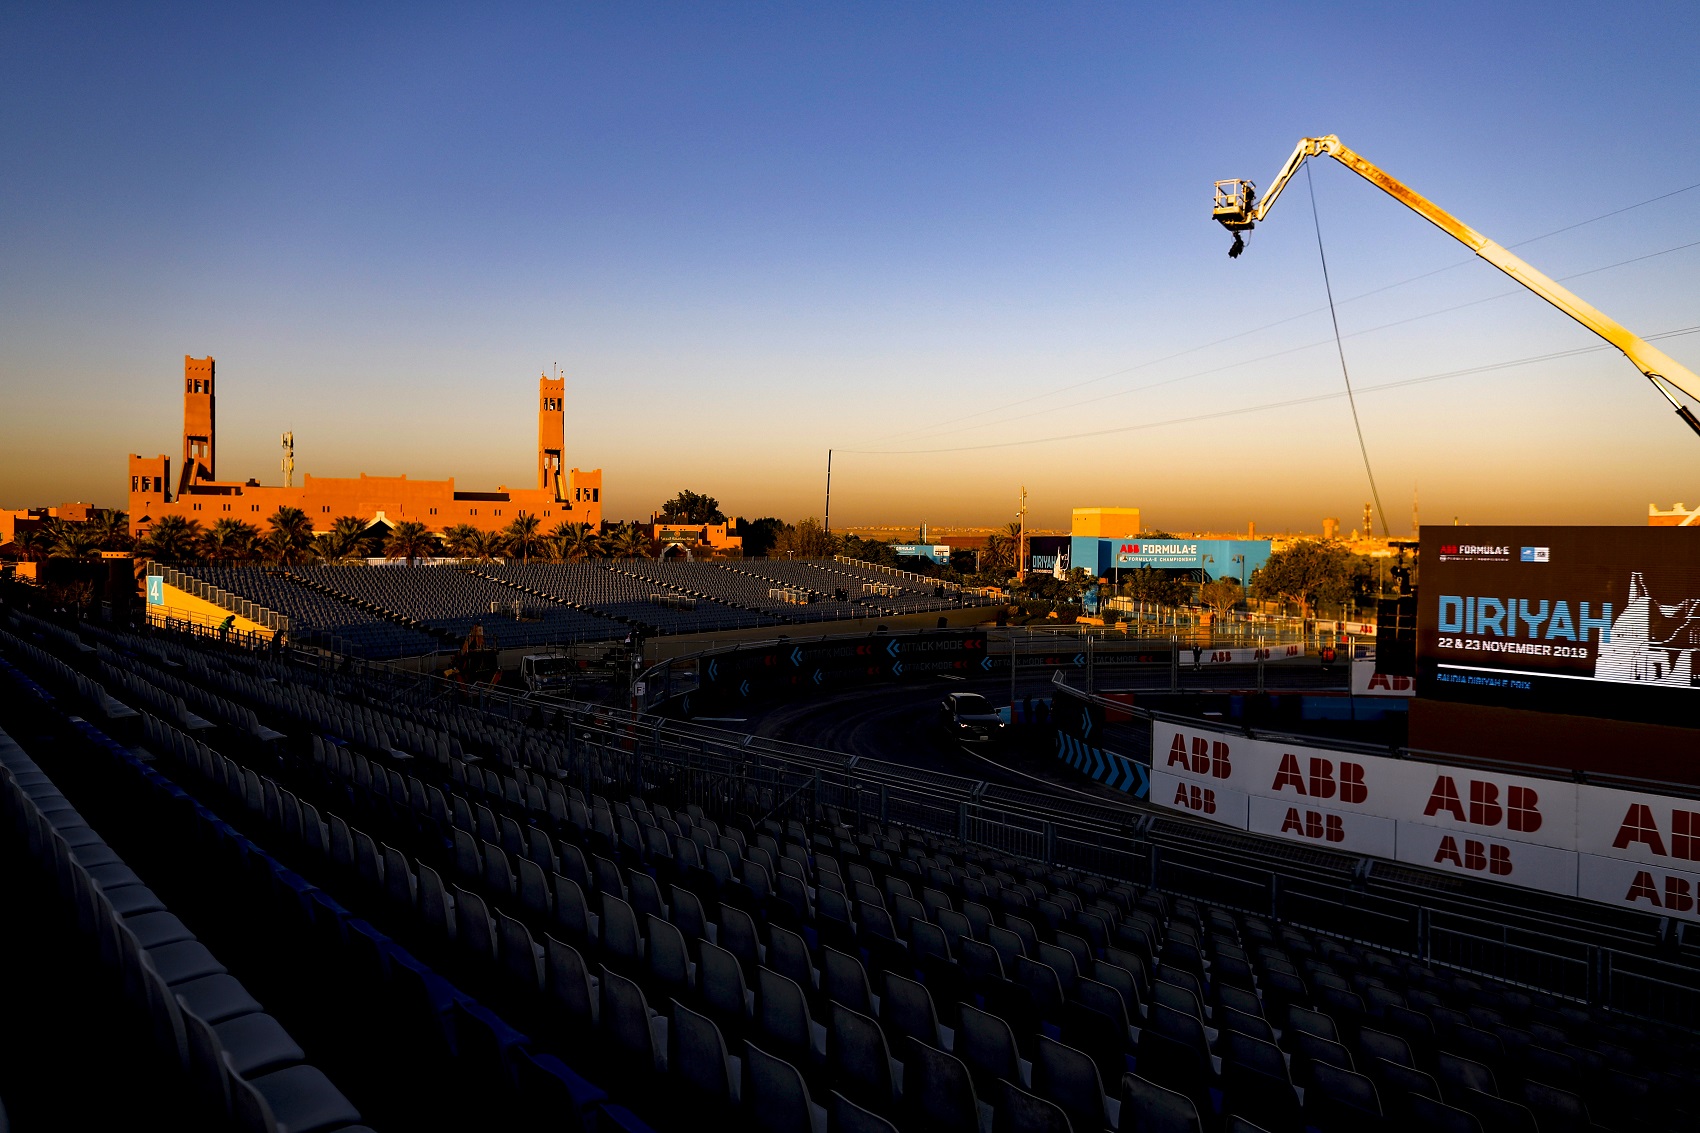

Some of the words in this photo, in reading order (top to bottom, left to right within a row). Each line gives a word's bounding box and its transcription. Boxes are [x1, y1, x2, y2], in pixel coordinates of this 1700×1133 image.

[1120, 544, 1140, 553] ABB
[150, 581, 160, 600] 4
[1438, 595, 1613, 643] DIRIYAH
[993, 658, 1020, 667] ATTAK
[1211, 651, 1232, 662] ABB
[1437, 637, 1453, 649] 22
[1454, 638, 1463, 649] &
[1464, 639, 1482, 651] 23
[1482, 640, 1552, 656] NOVEMBER
[1553, 646, 1589, 659] 2019
[1167, 733, 1231, 780] ABB
[1271, 753, 1368, 804] ABB
[1174, 782, 1216, 815] ABB
[1423, 775, 1542, 833] ABB
[1281, 807, 1345, 842] ABB
[1434, 835, 1513, 876] ABB
[1625, 870, 1700, 915] AB
